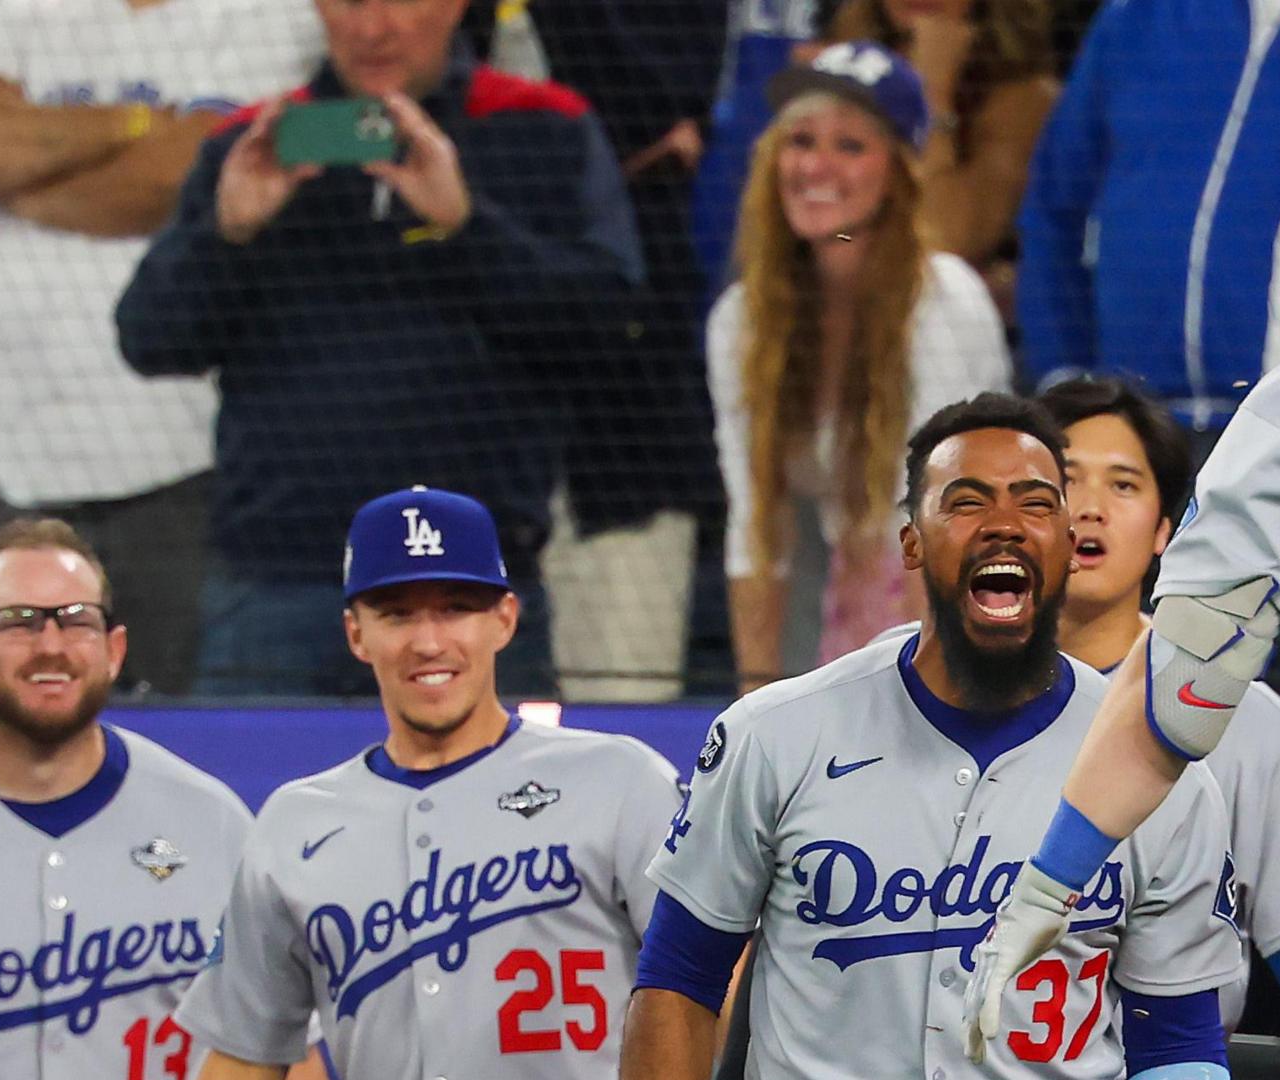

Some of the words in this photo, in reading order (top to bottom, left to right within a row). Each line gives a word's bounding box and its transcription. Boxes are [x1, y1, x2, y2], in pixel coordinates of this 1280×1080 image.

[401, 507, 445, 557] LA
[306, 843, 582, 1014] Dodgers
[494, 948, 608, 1054] 25
[1006, 950, 1109, 1063] 37
